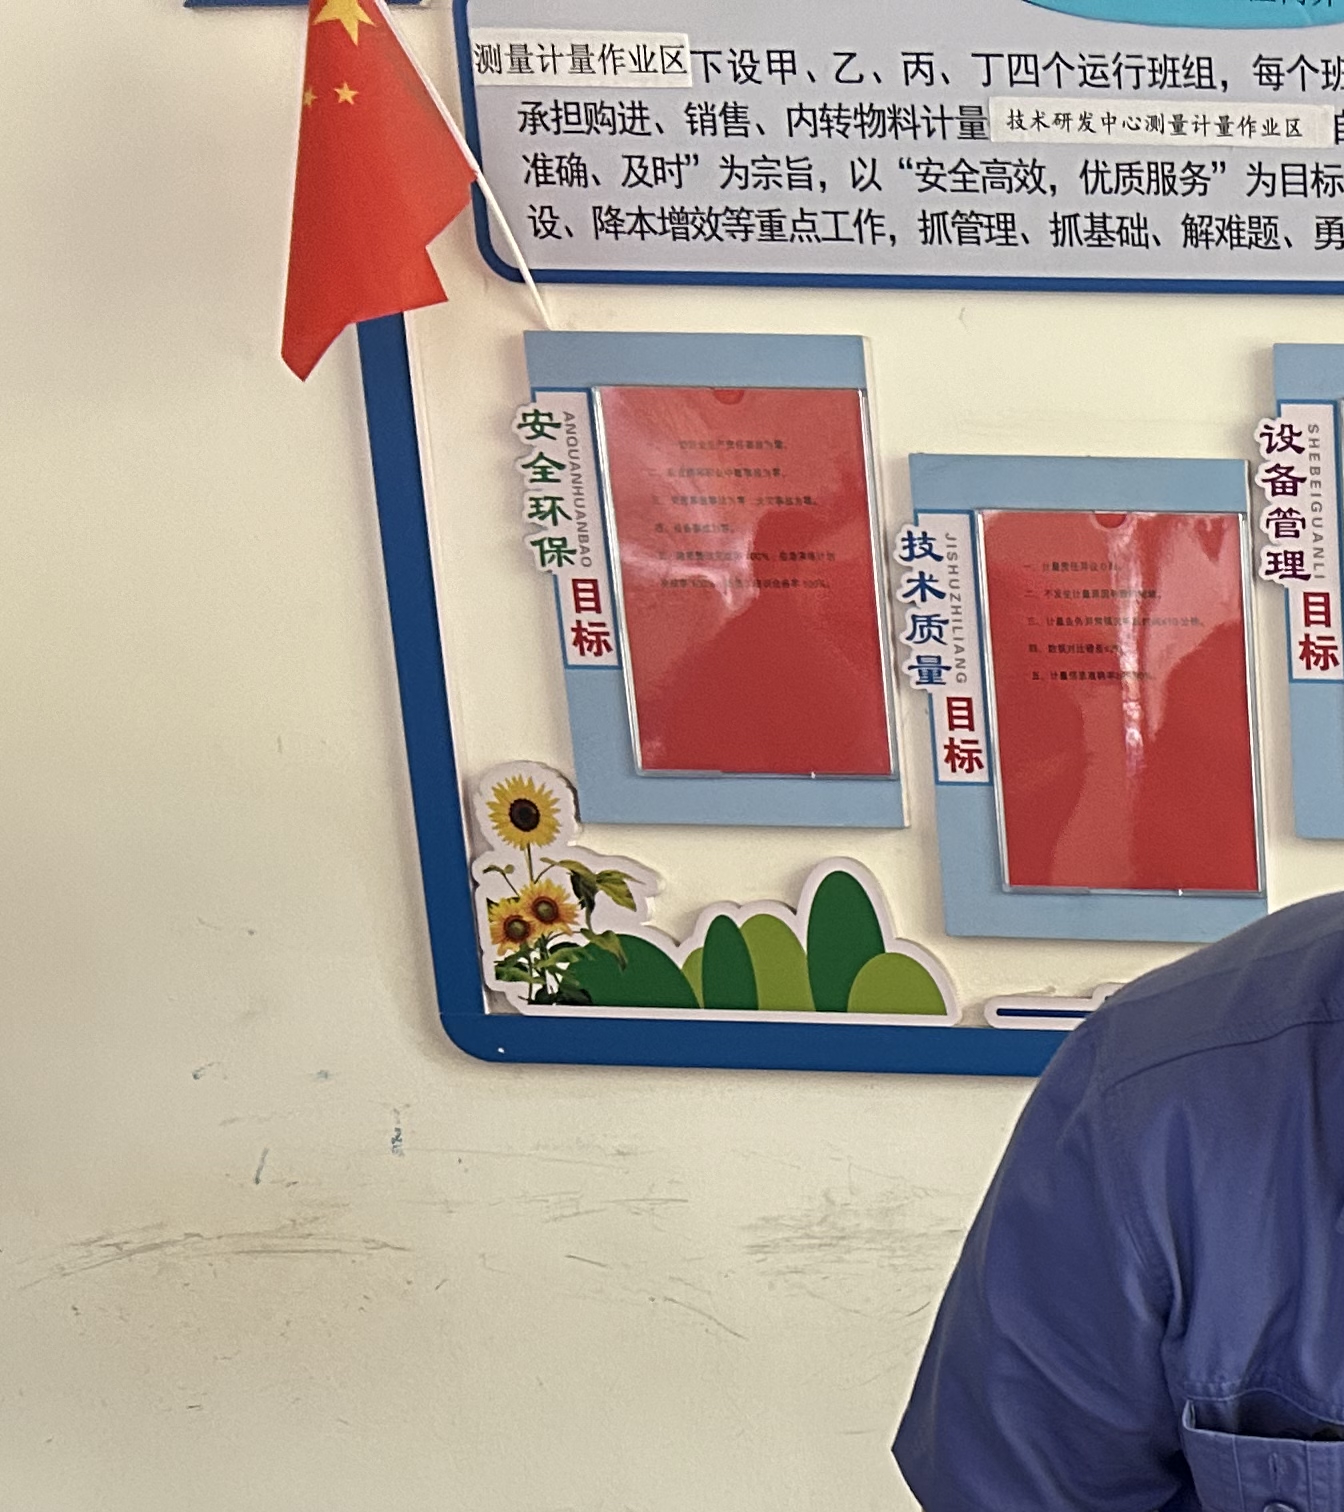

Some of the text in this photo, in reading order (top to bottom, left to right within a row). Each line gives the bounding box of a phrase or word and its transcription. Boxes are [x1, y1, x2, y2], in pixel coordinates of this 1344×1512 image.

[474, 44, 687, 75] 测量计量作业区
[518, 100, 988, 140] 承担购进、销售、内转物料计量
[1007, 110, 1302, 137] 技术研发中心测量计量作业区
[517, 409, 613, 657] 安全环保 目标
[562, 411, 592, 567] ANQUANHUANBAO
[1259, 424, 1339, 670] 设备管理 目标
[1308, 424, 1325, 579] SHEBEIGUANLI
[899, 531, 984, 774] 技术质量 目标
[945, 533, 967, 684] JISHUZHILIANG
